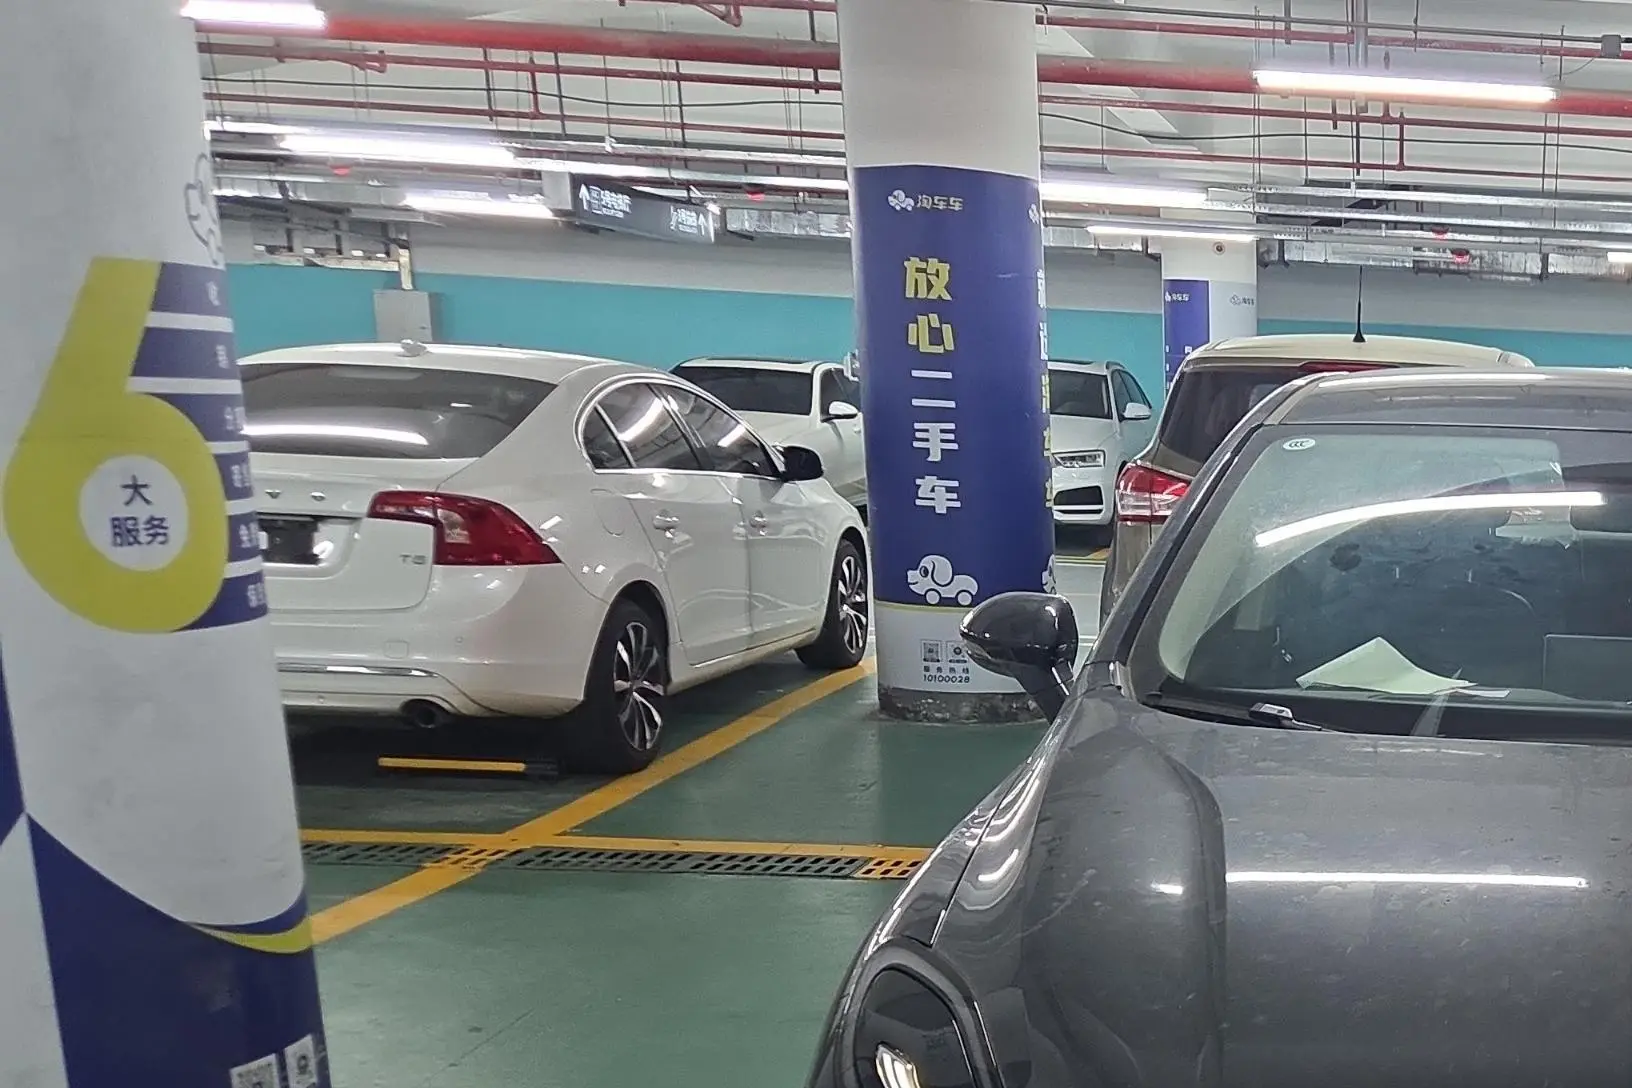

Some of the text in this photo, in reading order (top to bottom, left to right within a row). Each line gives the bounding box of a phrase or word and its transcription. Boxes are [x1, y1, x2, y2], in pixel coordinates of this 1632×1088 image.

[917, 194, 964, 211] 淘车车
[904, 257, 961, 514] 放心二手车
[121, 474, 153, 506] 大
[111, 514, 169, 548] 服务
[923, 674, 970, 683] 10100028
